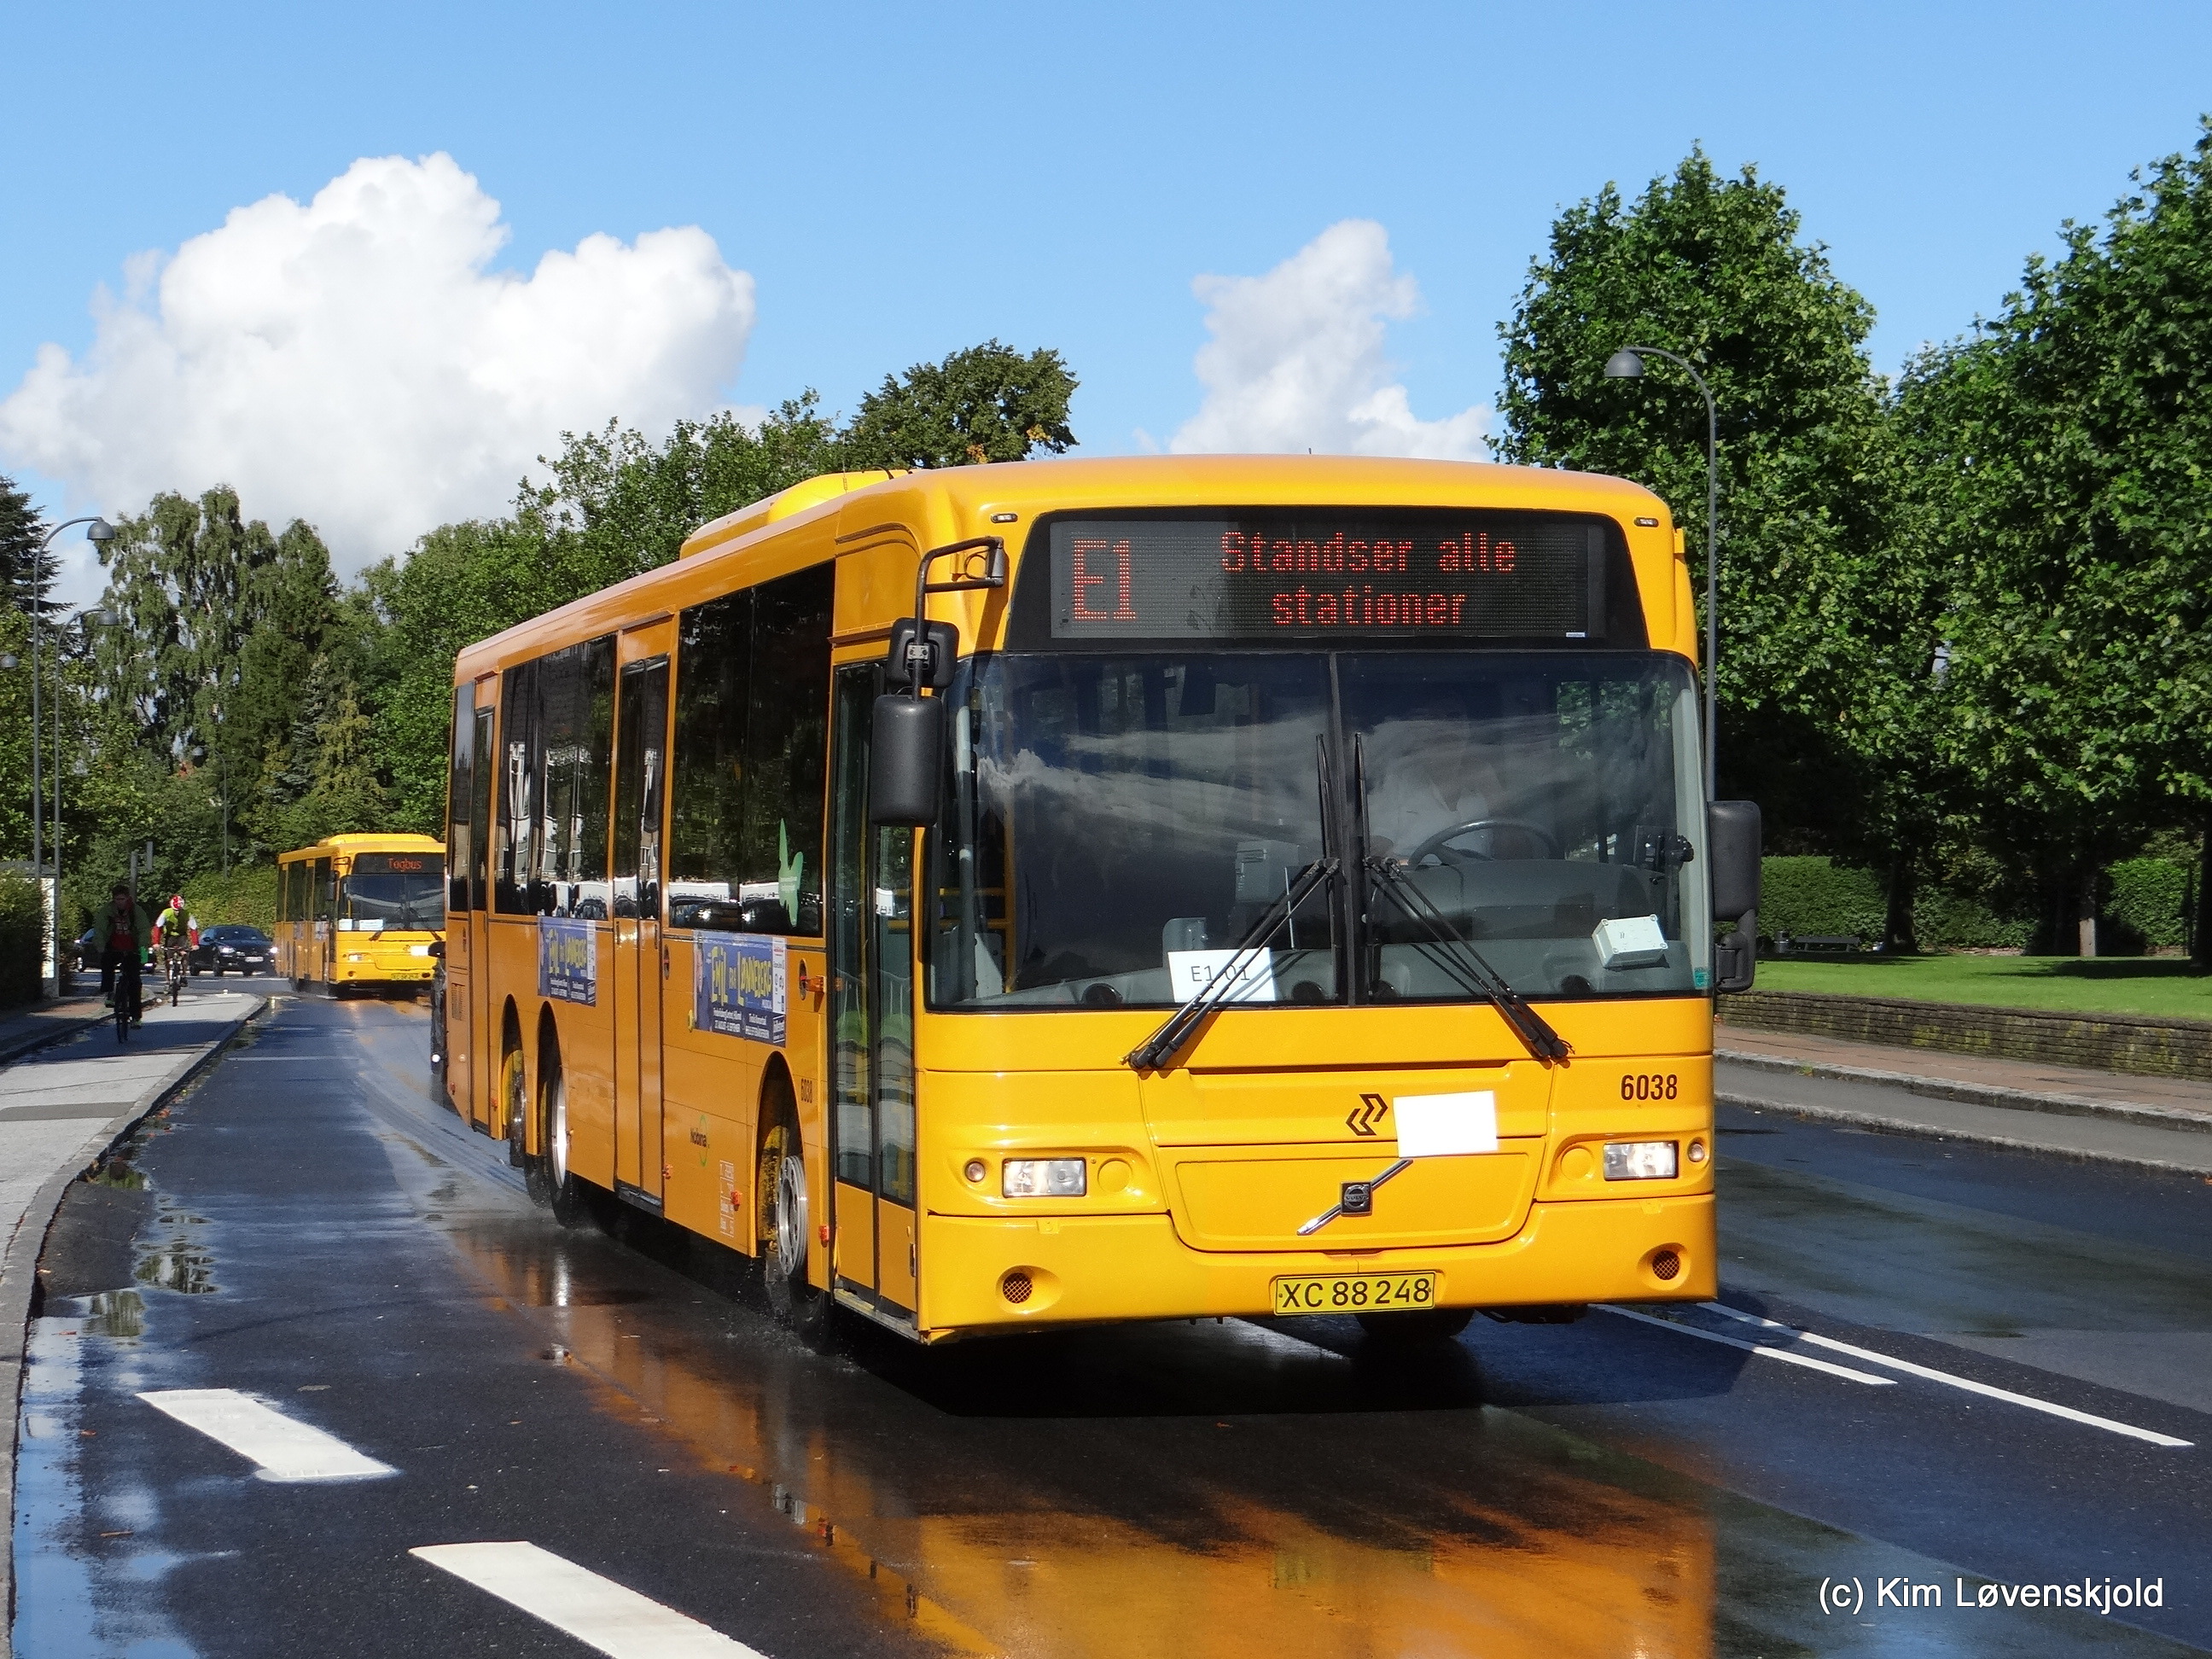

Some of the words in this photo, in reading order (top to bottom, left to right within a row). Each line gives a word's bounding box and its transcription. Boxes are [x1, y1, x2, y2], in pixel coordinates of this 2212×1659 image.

[1220, 531, 1414, 573] Standser
[1437, 532, 1516, 573] alle
[1072, 538, 1137, 621] E1
[1272, 585, 1466, 626] stationer
[1190, 965, 1213, 981] E1
[1621, 1074, 1678, 1100] 6038
[1282, 1283, 1324, 1308] XC
[1331, 1281, 1368, 1306] 88
[1375, 1278, 1430, 1304] 248
